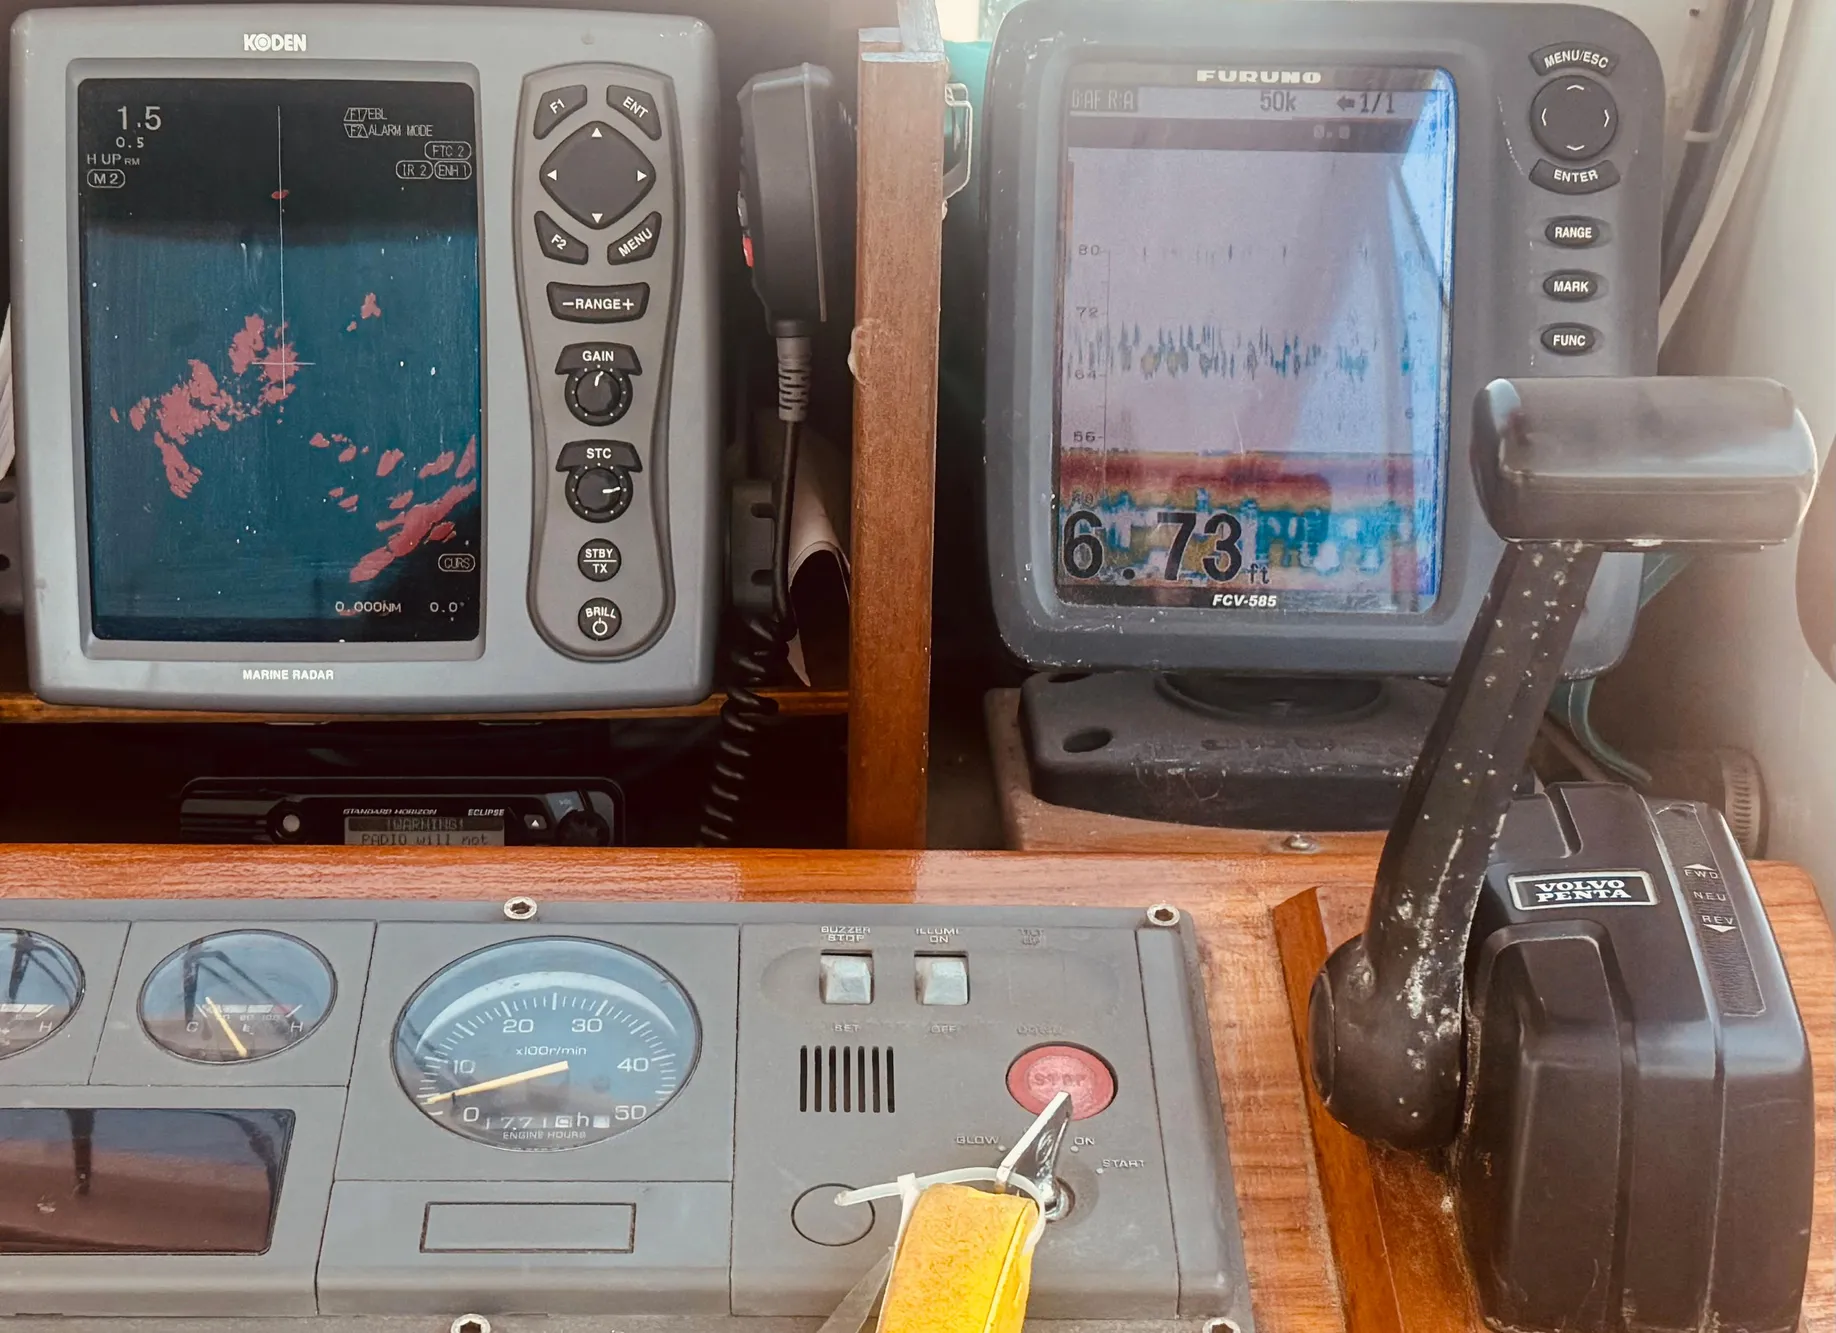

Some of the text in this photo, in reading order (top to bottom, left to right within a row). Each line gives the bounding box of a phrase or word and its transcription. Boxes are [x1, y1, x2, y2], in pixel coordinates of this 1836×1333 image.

[243, 33, 308, 53] KODEN
[1543, 49, 1609, 69] MENU/ESC
[1196, 70, 1322, 84] FURUNO
[549, 98, 566, 115] F1
[622, 95, 649, 119] ENT
[1259, 90, 1297, 112] 50k
[1360, 91, 1395, 114] 1/1
[117, 105, 162, 131] 1.5
[368, 123, 402, 137] ALARM
[406, 124, 434, 137] MODE
[115, 136, 145, 148] 0.5
[1553, 168, 1599, 183] ENTER
[1554, 226, 1592, 239] RANGE
[550, 234, 567, 250] F2
[617, 227, 653, 257] MENU
[1553, 281, 1590, 293] MARK
[1552, 335, 1586, 347] FUNC
[582, 350, 614, 362] GAIN
[586, 448, 612, 459] STC
[1062, 509, 1271, 585] 6.73 ft
[585, 548, 614, 560] STBY
[444, 558, 471, 569] CURS
[592, 563, 608, 573] TX
[1212, 593, 1278, 607] FCV-585
[585, 607, 617, 619] BRILL
[243, 669, 334, 680] MARINE RADAR
[467, 808, 505, 816] ECLIPSE
[1684, 869, 1719, 880] FWD
[1534, 879, 1626, 893] VOLVO
[1535, 888, 1632, 903] PENTA
[1693, 890, 1727, 902] NEU
[1701, 914, 1735, 926] REV
[820, 925, 872, 935] BUZZER
[827, 934, 865, 942] STOP
[929, 935, 949, 944] ON
[39, 1021, 53, 1032] H
[186, 1021, 199, 1033] C
[290, 1021, 304, 1033] H
[502, 1018, 535, 1033] 20
[571, 1018, 603, 1033] 30
[452, 1059, 476, 1075] 10
[616, 1057, 649, 1072] 40
[462, 1107, 480, 1123] 0
[614, 1105, 647, 1121] 50
[503, 1131, 544, 1140] ENGINE
[955, 1135, 1000, 1145] GLOW
[1073, 1136, 1095, 1146] ON
[1102, 1159, 1145, 1169] START
